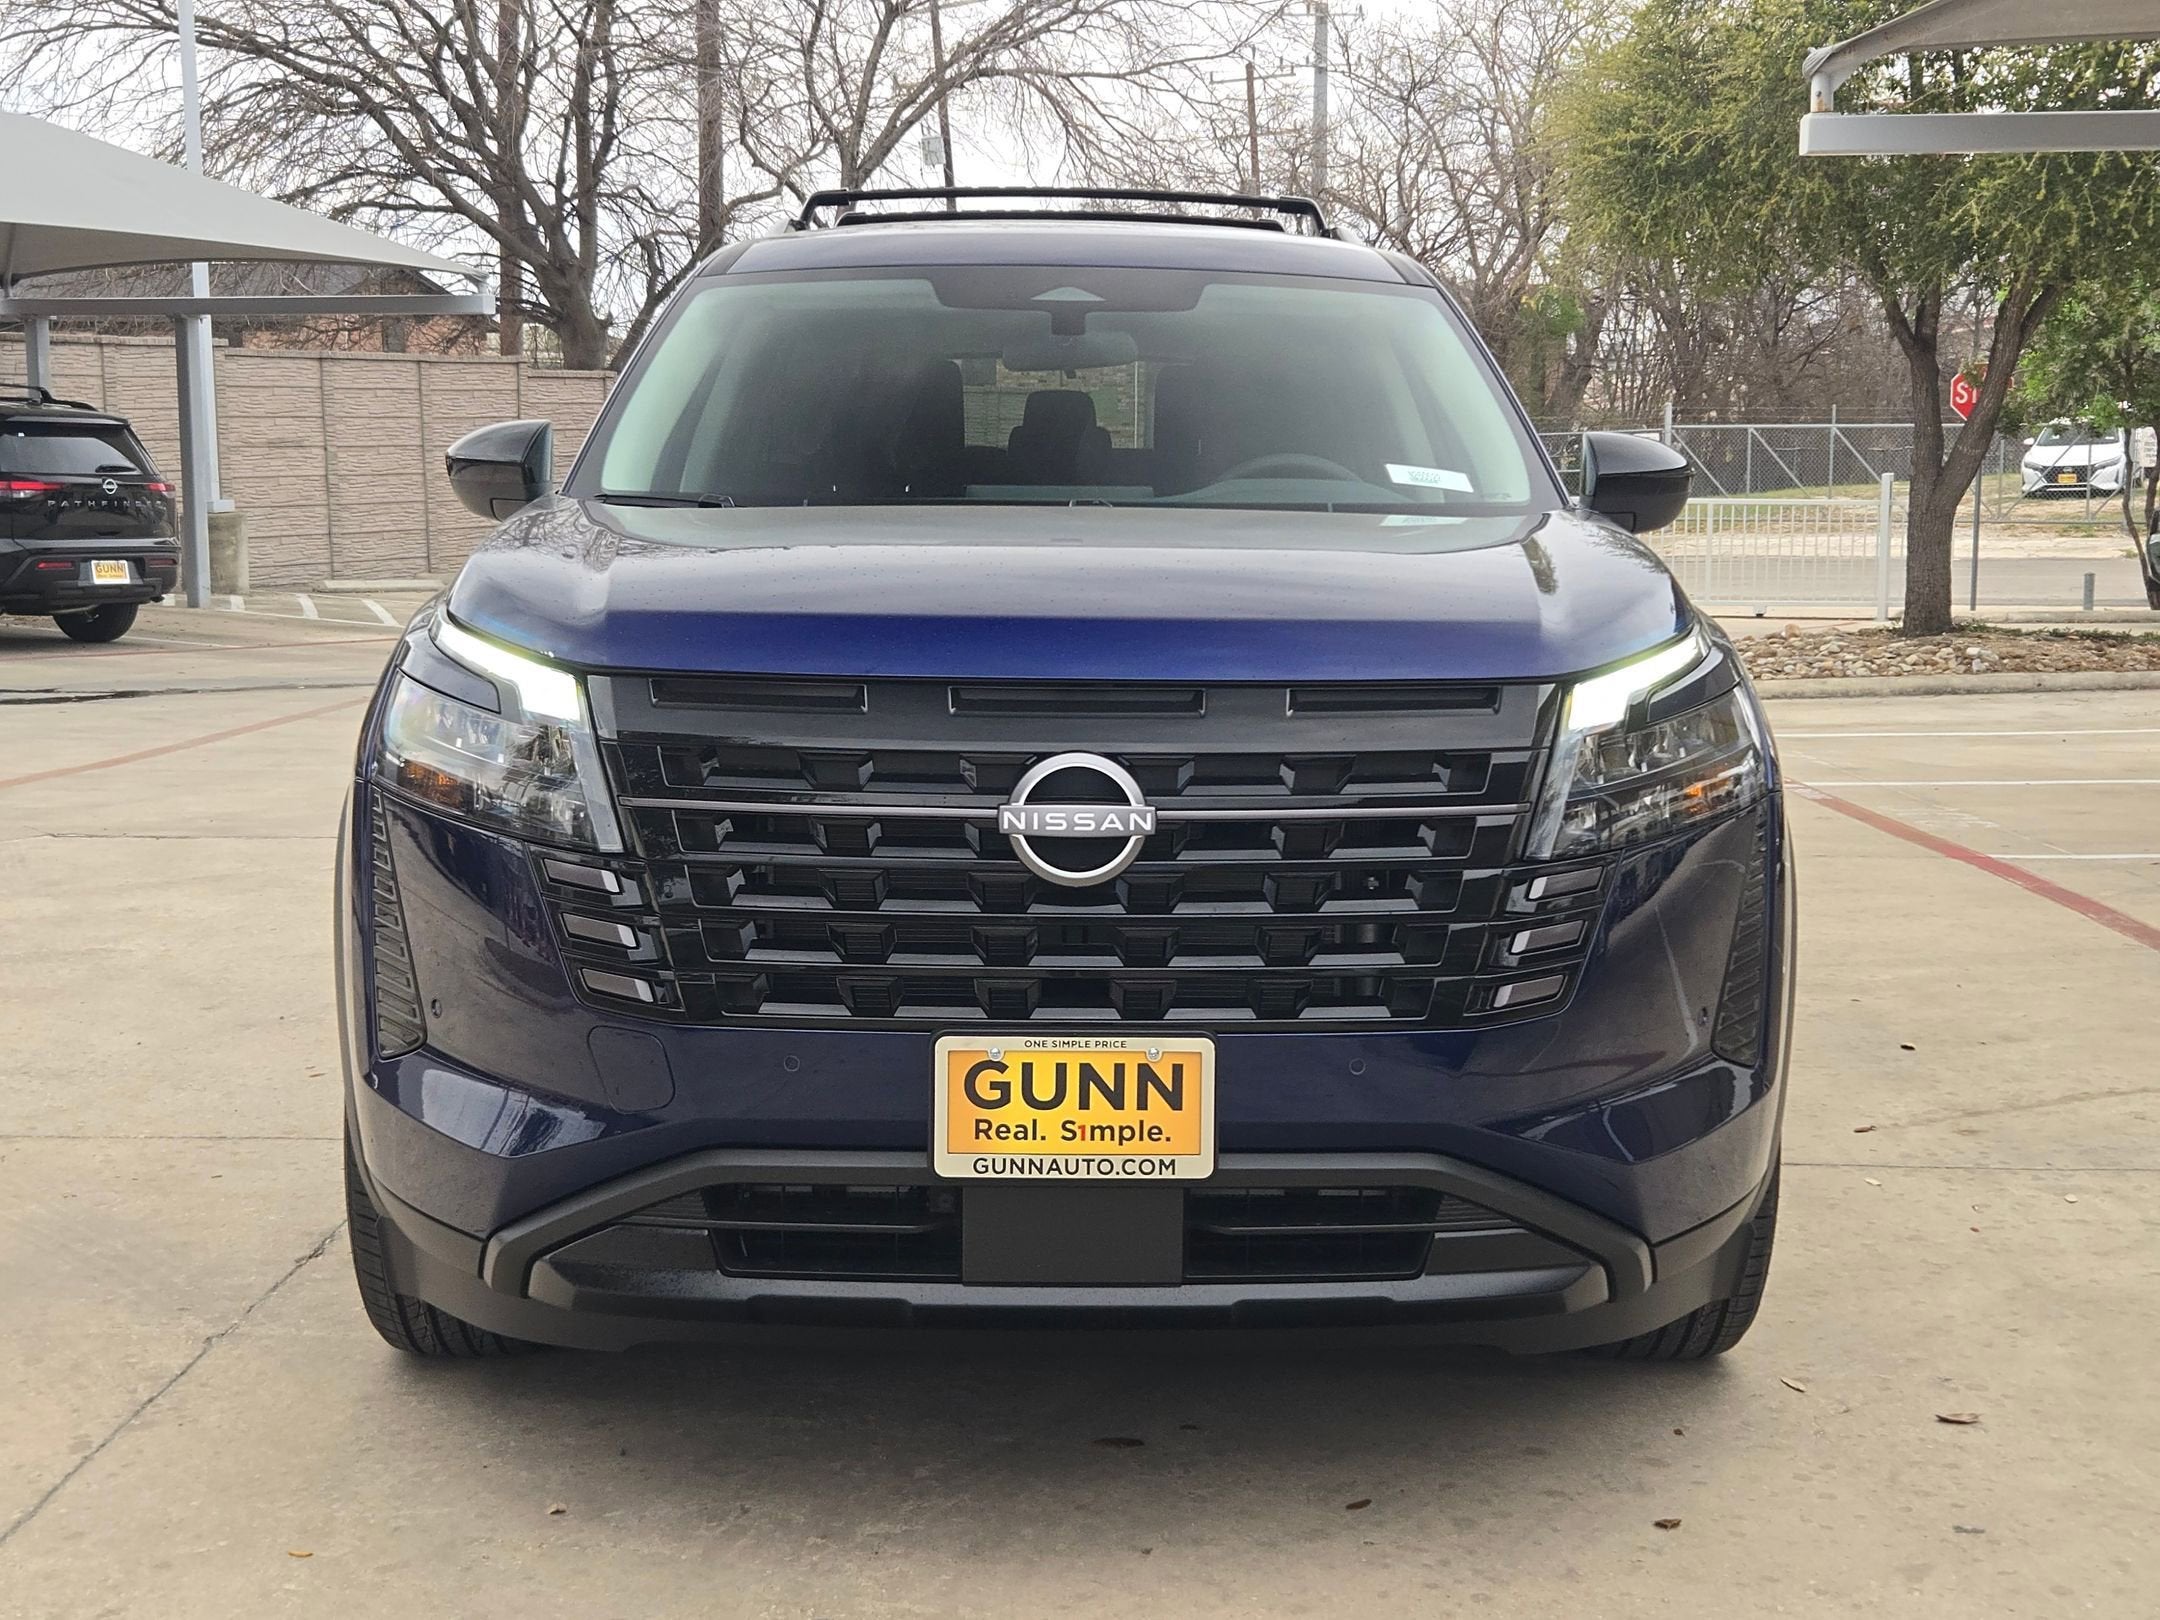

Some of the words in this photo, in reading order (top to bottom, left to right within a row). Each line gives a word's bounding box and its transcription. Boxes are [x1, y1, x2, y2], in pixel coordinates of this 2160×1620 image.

[1955, 381, 1981, 404] ST
[47, 499, 162, 507] PATHFIN
[96, 563, 124, 573] GUNN
[1003, 811, 1152, 831] NISSAN
[1024, 1040, 1048, 1049] ONE
[1051, 1040, 1091, 1049] SIMPLE
[1094, 1040, 1127, 1049] PRICE
[964, 1059, 1184, 1112] GUNN
[974, 1118, 1047, 1141] Real.
[972, 1157, 1176, 1176] GUNNAUTO.COM
